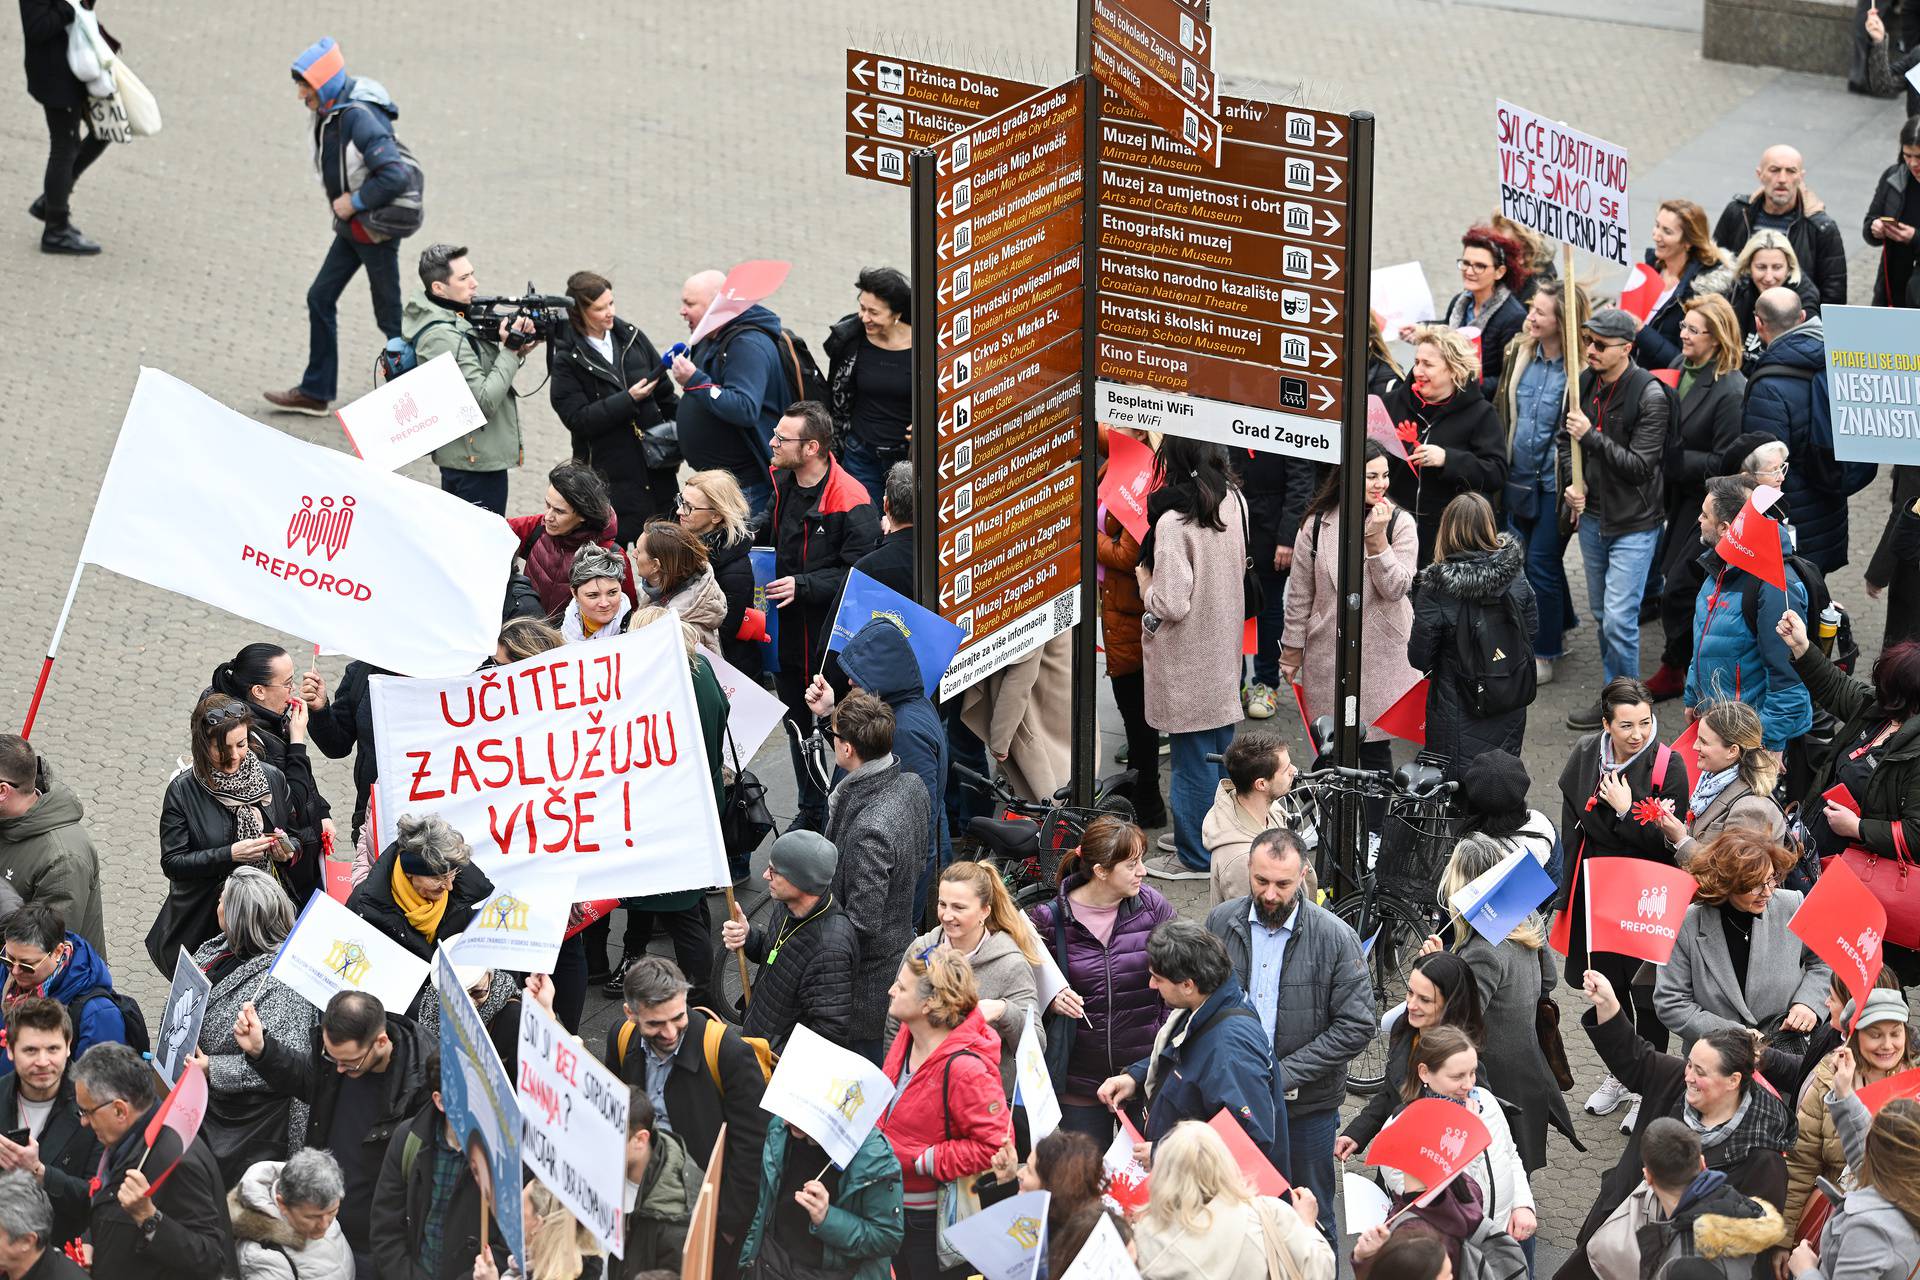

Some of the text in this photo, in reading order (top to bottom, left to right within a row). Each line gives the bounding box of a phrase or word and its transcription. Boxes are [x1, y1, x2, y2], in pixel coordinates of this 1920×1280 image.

[1095, 1, 1176, 67] Muzej čokolade Zagreb
[907, 66, 1000, 98] Tržnica Dolac
[1094, 45, 1141, 88] Muzej vlakića
[907, 86, 980, 110] Dolac Market
[972, 92, 1066, 147] Muzej grada Zagreba
[1225, 104, 1262, 121] arhiv
[972, 103, 1076, 163] Museum of the City of Zagreb
[1103, 126, 1146, 150] Muzej
[1498, 108, 1627, 193] SVI ĆE DOBITI PUNO
[972, 130, 1066, 188] Galerija Mijo Kovačić
[1102, 145, 1201, 172] Mimara Museum
[973, 159, 1045, 205] Gallery Mijo Kovačić
[973, 164, 1081, 231] Hrvatski prirodoslovni muzej
[1102, 170, 1280, 214] Muzej za umjetnost i obrt
[1542, 164, 1592, 215] SAMO
[1599, 196, 1619, 220] SE
[973, 186, 1081, 246] Croatian Natural History Museum
[1101, 189, 1242, 223] Arts and Crafts Museum
[972, 225, 1045, 275] Atelje Meštrović
[1101, 232, 1232, 265] Ethnographic Museum
[1102, 213, 1231, 252] Etnografski muzej
[1566, 210, 1596, 253] CRNO
[1599, 220, 1627, 266] PIŠE
[972, 253, 1033, 291] Meštrović Atelier
[973, 251, 1079, 319] Hrvatski povijesni muzej
[1101, 257, 1278, 301] Hrvatsko narodno kazalište
[1101, 276, 1247, 312] Croatian National Theatre
[973, 282, 1062, 335] Croatian History Museum
[1101, 299, 1260, 345] Hrvatski školski muzej
[973, 308, 1059, 362] Crkva Sv. Marka Ev.
[973, 366, 982, 378] St.
[1009, 337, 1035, 359] Church
[1101, 318, 1245, 354] Croatian School Museum
[1101, 342, 1187, 372] Kino Europa
[1101, 361, 1187, 387] Cinema Europa
[1831, 350, 1893, 370] PITATE LI SE
[973, 362, 1039, 406] Kamenita vrata
[1108, 390, 1193, 416] Besplatni WiFi
[1834, 372, 1912, 405] NESTALI
[390, 415, 439, 443] PREPOROD
[972, 394, 1012, 422] Stone Gate
[974, 382, 1080, 449] Hrvatski muzej naivne umjetnosti
[1108, 408, 1160, 426] Free WiFi
[1231, 419, 1329, 449] Grad Zagreb
[974, 424, 1073, 491] Galerija Klovićevi dvori
[973, 458, 1050, 508] Klovićevi dvori Gallery
[974, 475, 1074, 536] Muzej prekinutih veza
[973, 515, 1070, 578] Državni arhiv u Zagrebu
[973, 539, 1057, 593] State Archives in Zagreb
[241, 544, 372, 602] PREPOROD
[975, 562, 1057, 619] Muzej Zagreb 80-ih
[974, 613, 1000, 635] Zagreb
[1013, 590, 1043, 613] Museum
[943, 613, 1046, 678] Skenirajte za više informacija
[962, 636, 1033, 684] for more information
[440, 652, 622, 728] UČITELJI
[406, 709, 678, 802] ZASLUŽUJU
[1620, 919, 1676, 940] PREPOROD
[555, 1040, 578, 1088] BEZ
